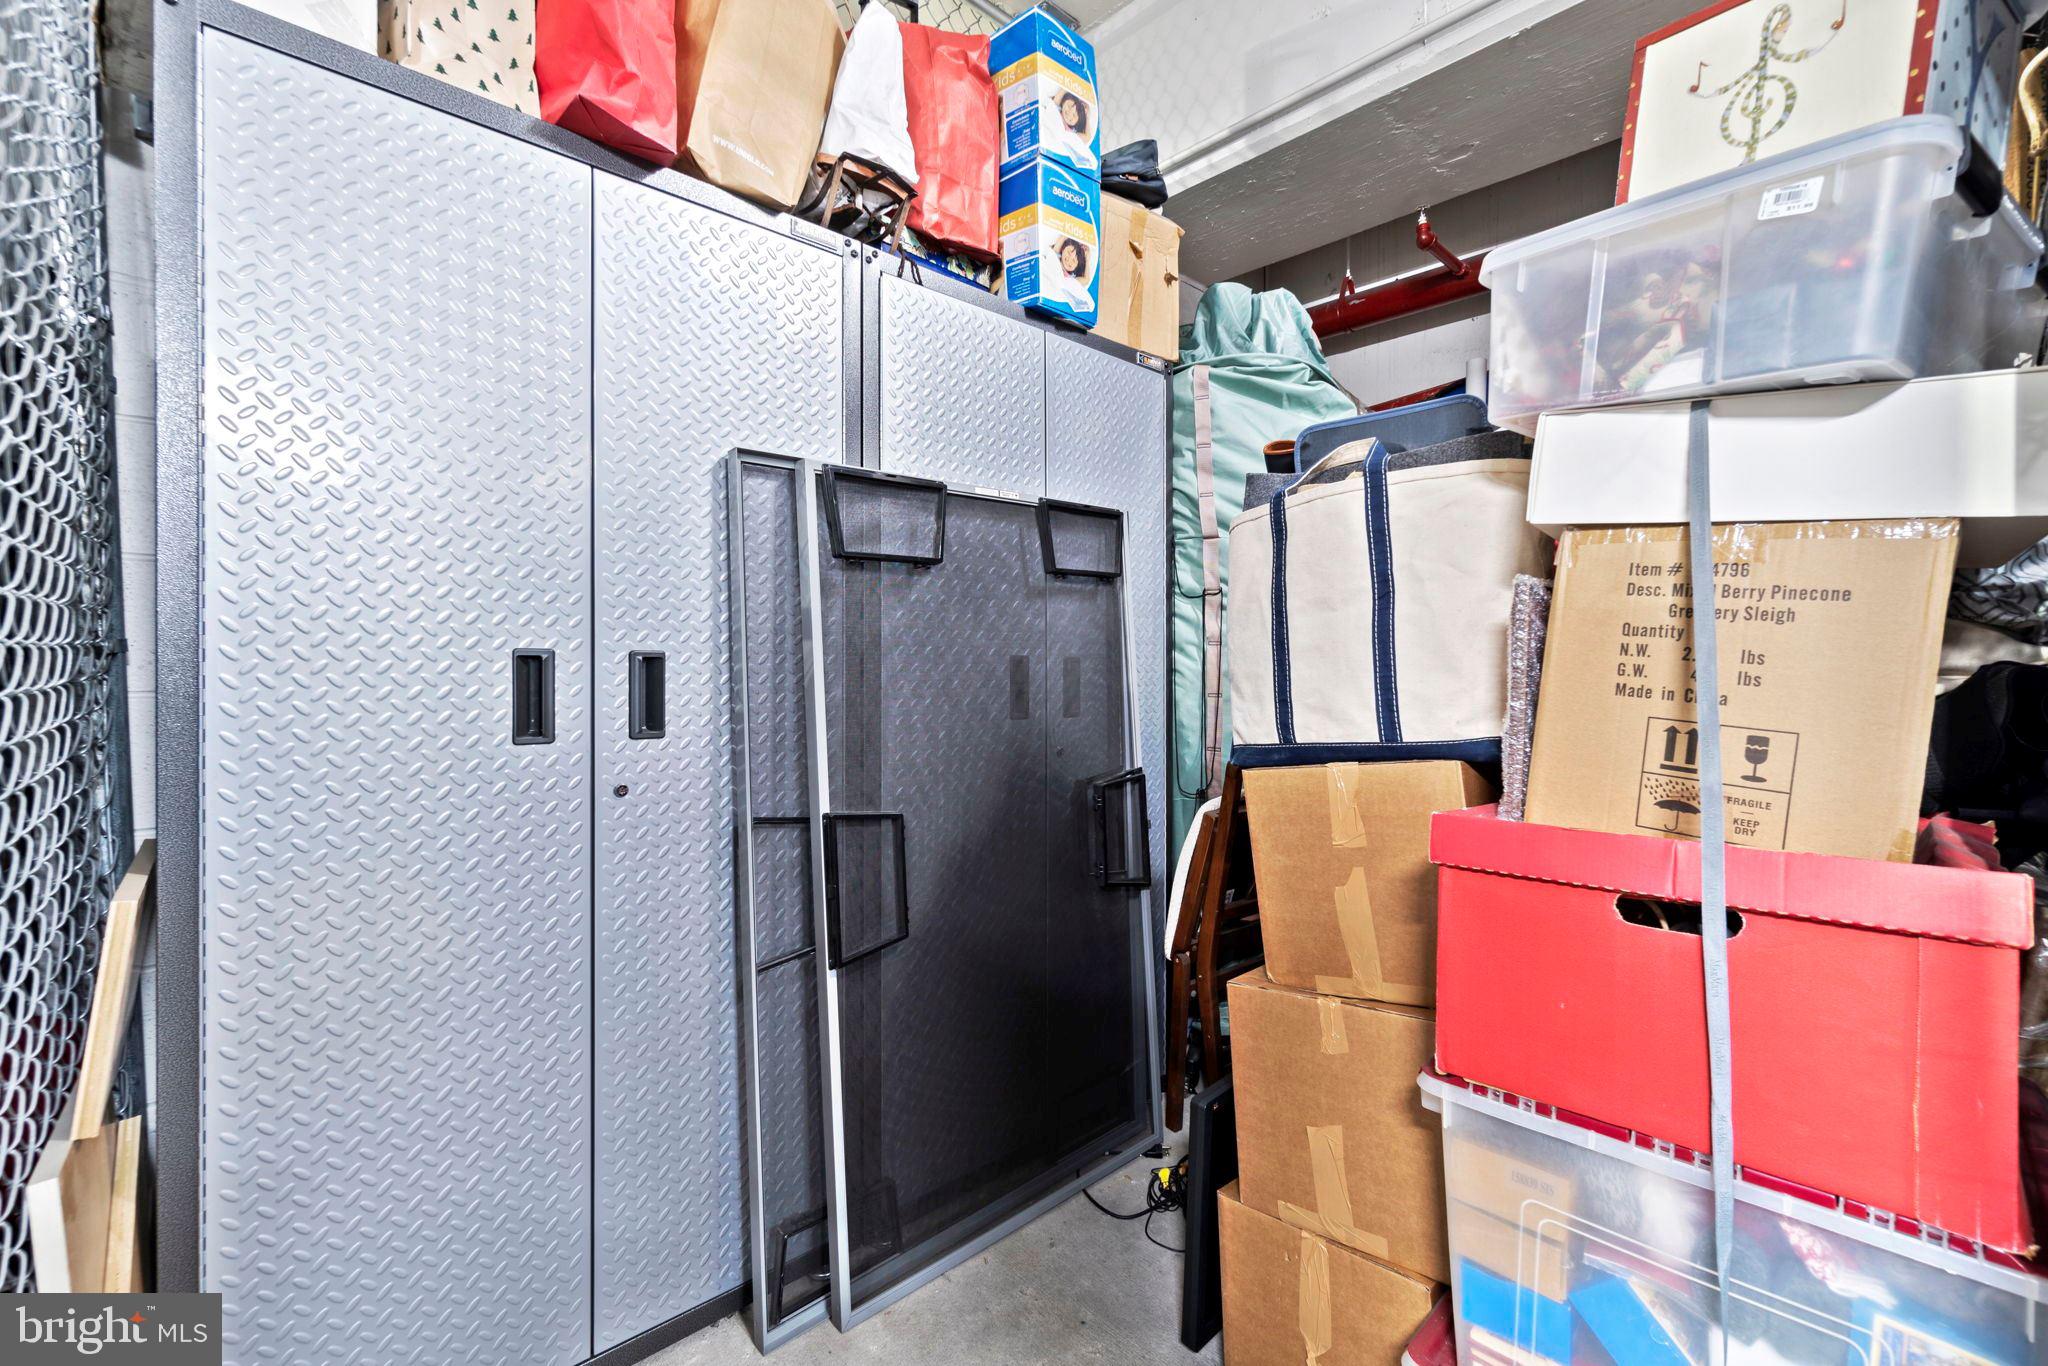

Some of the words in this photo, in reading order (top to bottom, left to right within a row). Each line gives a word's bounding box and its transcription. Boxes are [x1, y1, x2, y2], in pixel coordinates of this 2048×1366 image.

[1051, 38, 1083, 65] aerobed
[1052, 185, 1085, 207] aerobed
[999, 218, 1016, 234] ids
[1628, 562, 1662, 576] Item
[1666, 562, 1684, 577] #
[1626, 582, 1666, 597] Desc.
[1721, 584, 1765, 601] Berry
[1771, 585, 1852, 602] Pinecone
[1668, 603, 1740, 623] Greery
[1743, 606, 1796, 625] Sleigh
[1622, 622, 1685, 642] Quantity
[1619, 643, 1651, 658] N.W.
[1740, 649, 1765, 665] lbs
[1617, 663, 1648, 679] G.W.
[1737, 671, 1762, 687] lbs
[1614, 683, 1652, 700] Made
[1661, 686, 1676, 701] in
[1726, 796, 1773, 811] FRAGILE
[1732, 817, 1761, 829] KEEP
[1733, 826, 1757, 837] DRY
